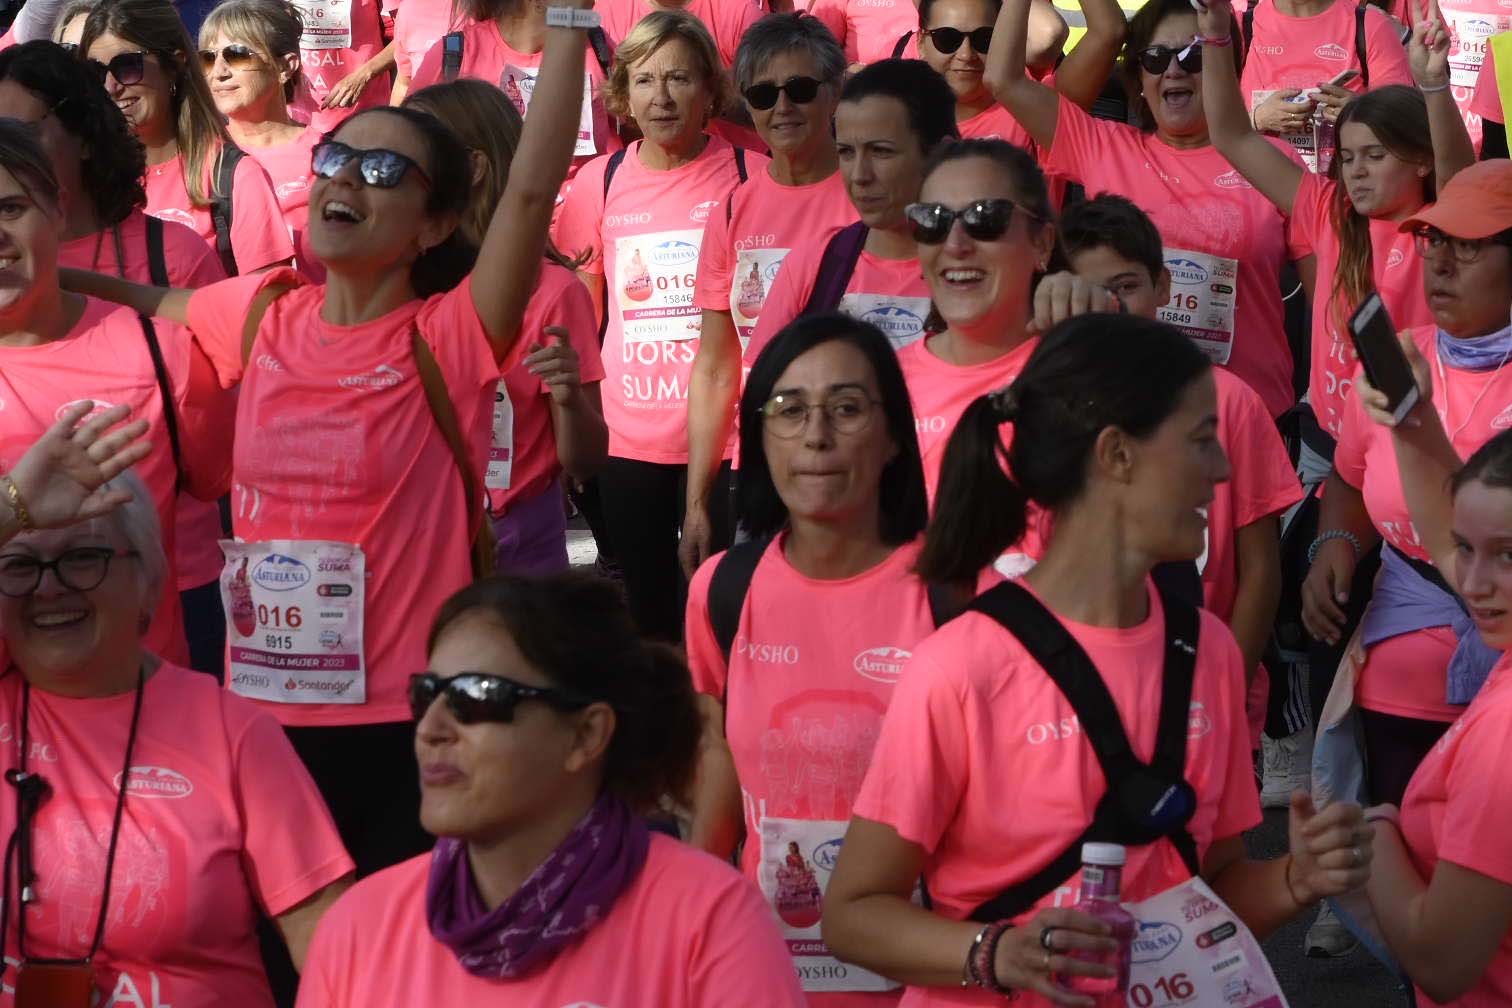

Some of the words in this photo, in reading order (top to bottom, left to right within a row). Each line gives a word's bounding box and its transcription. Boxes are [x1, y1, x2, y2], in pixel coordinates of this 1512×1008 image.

[606, 212, 651, 228] OYSHO
[656, 272, 695, 291] 016
[635, 308, 666, 319] CARRERA
[667, 308, 675, 317] DE
[676, 308, 685, 317] LA
[256, 567, 305, 583] ASTURIANA
[258, 603, 302, 628] 016
[287, 657, 320, 668] MUJER
[323, 658, 346, 668] 2023
[298, 677, 352, 694] Santander
